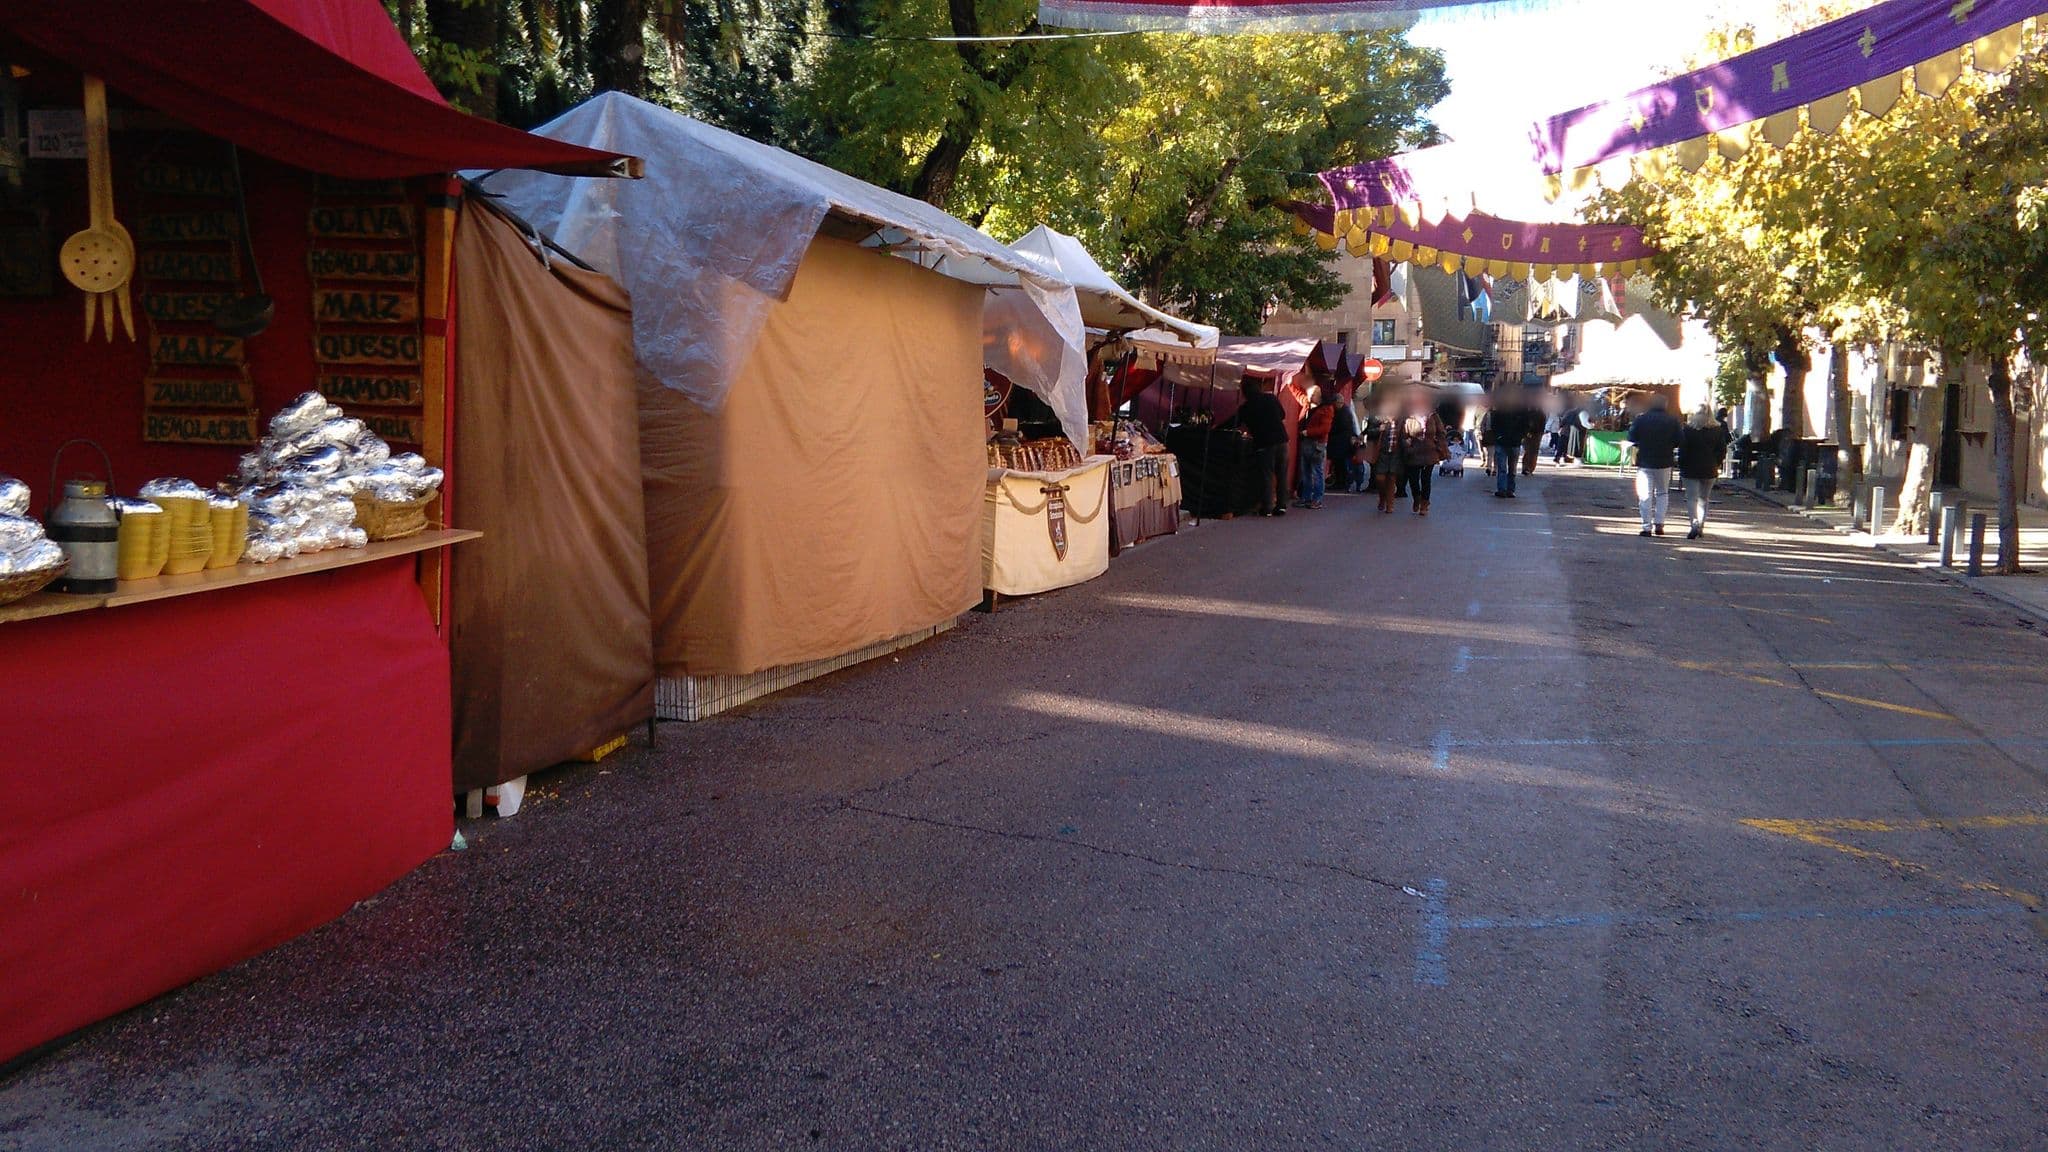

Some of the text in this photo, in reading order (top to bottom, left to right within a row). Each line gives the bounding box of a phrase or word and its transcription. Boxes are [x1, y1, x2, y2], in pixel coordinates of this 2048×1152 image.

[314, 207, 405, 234] OLIVA
[144, 253, 231, 280] JAMON
[319, 293, 400, 320] MAIZ
[153, 335, 237, 364] MAIZ
[320, 334, 418, 359] QUESO
[322, 373, 411, 401] JAMON
